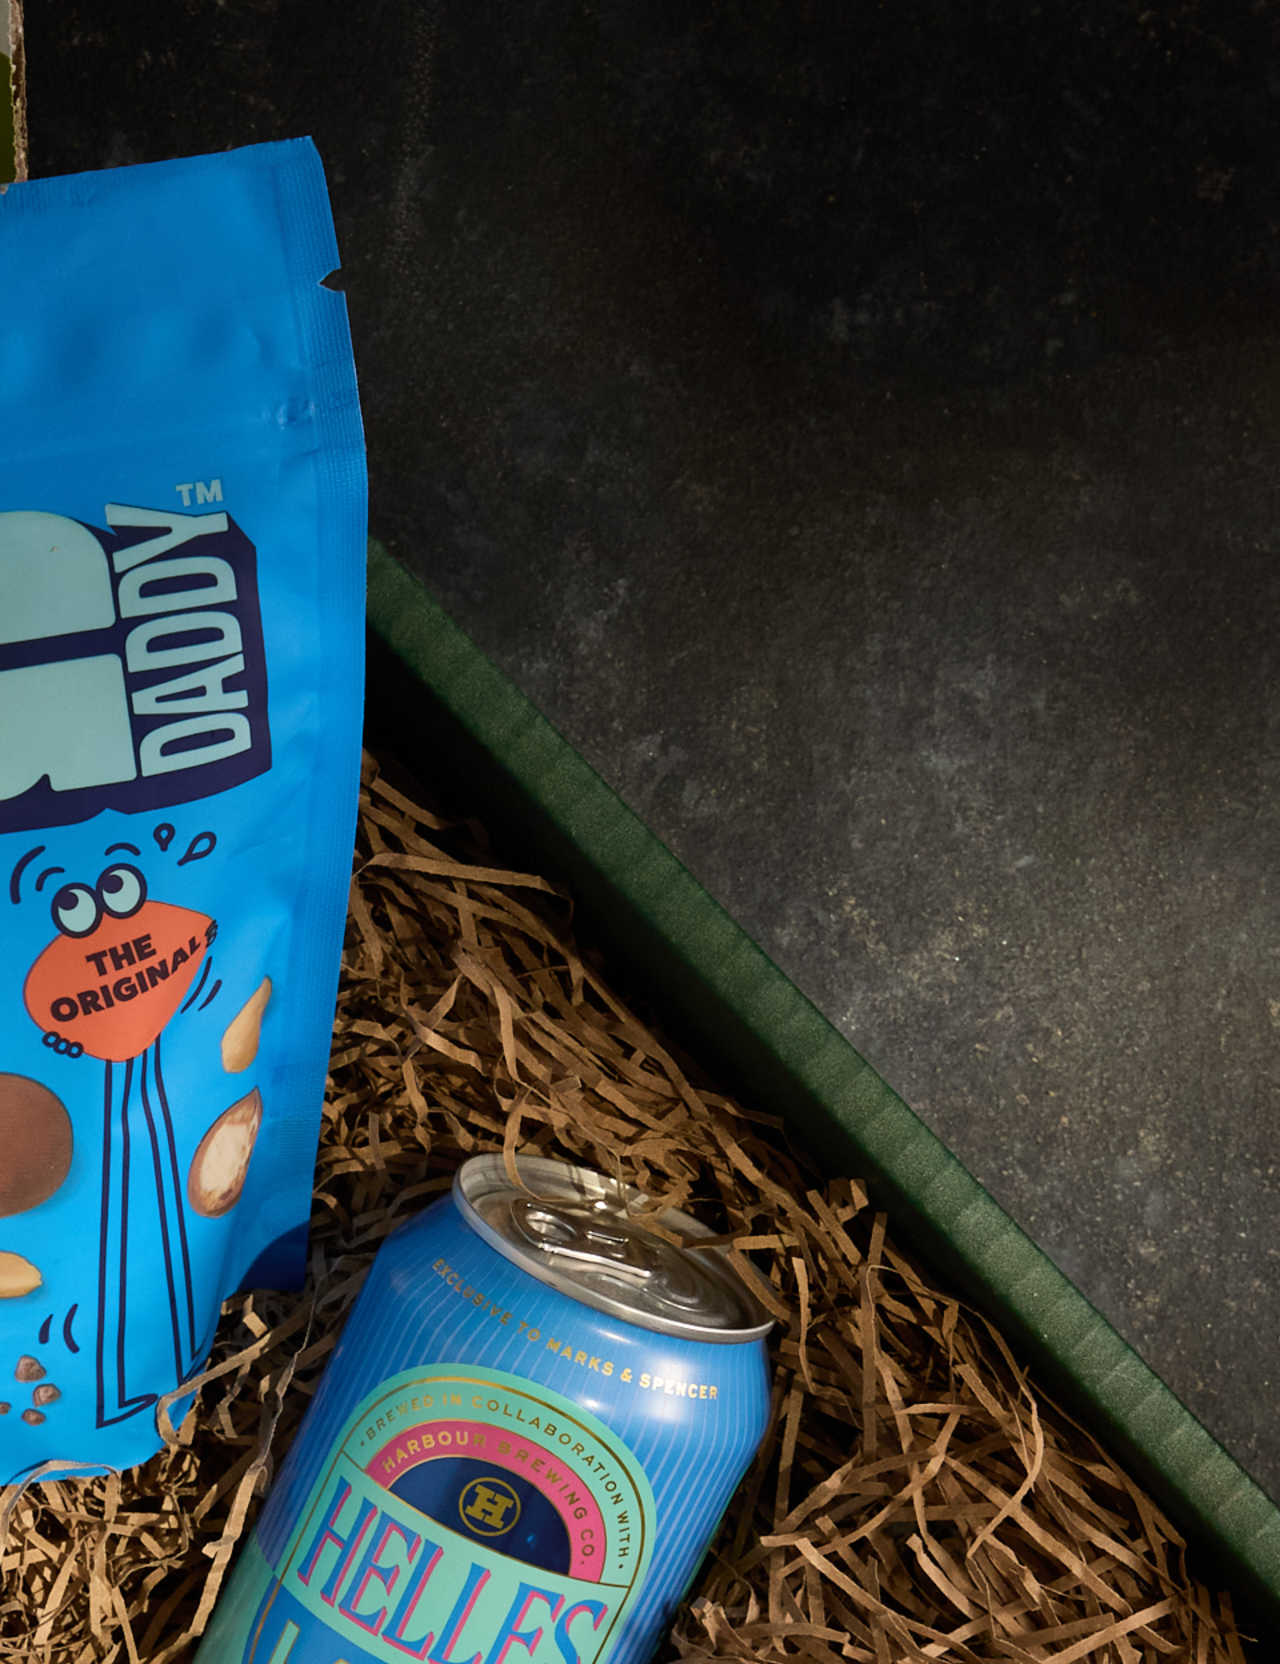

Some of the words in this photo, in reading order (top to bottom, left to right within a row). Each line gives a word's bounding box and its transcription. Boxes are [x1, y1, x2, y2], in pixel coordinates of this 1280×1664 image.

[175, 479, 223, 507] TM
[104, 503, 252, 778] DADDY
[49, 935, 201, 1023] ORIGINAL
[84, 933, 157, 977] THE
[431, 1257, 514, 1327] EXCLUSIVE
[517, 1320, 541, 1342] TO
[545, 1338, 615, 1377] MARKS
[619, 1367, 633, 1384] &
[638, 1372, 719, 1400] SPENCER
[366, 1394, 435, 1441] BREWED
[441, 1393, 462, 1406] IN
[471, 1396, 624, 1506] COLLABORATION
[616, 1510, 631, 1562] WITH
[381, 1431, 487, 1474] HARBOUR
[496, 1439, 589, 1521] BREWING
